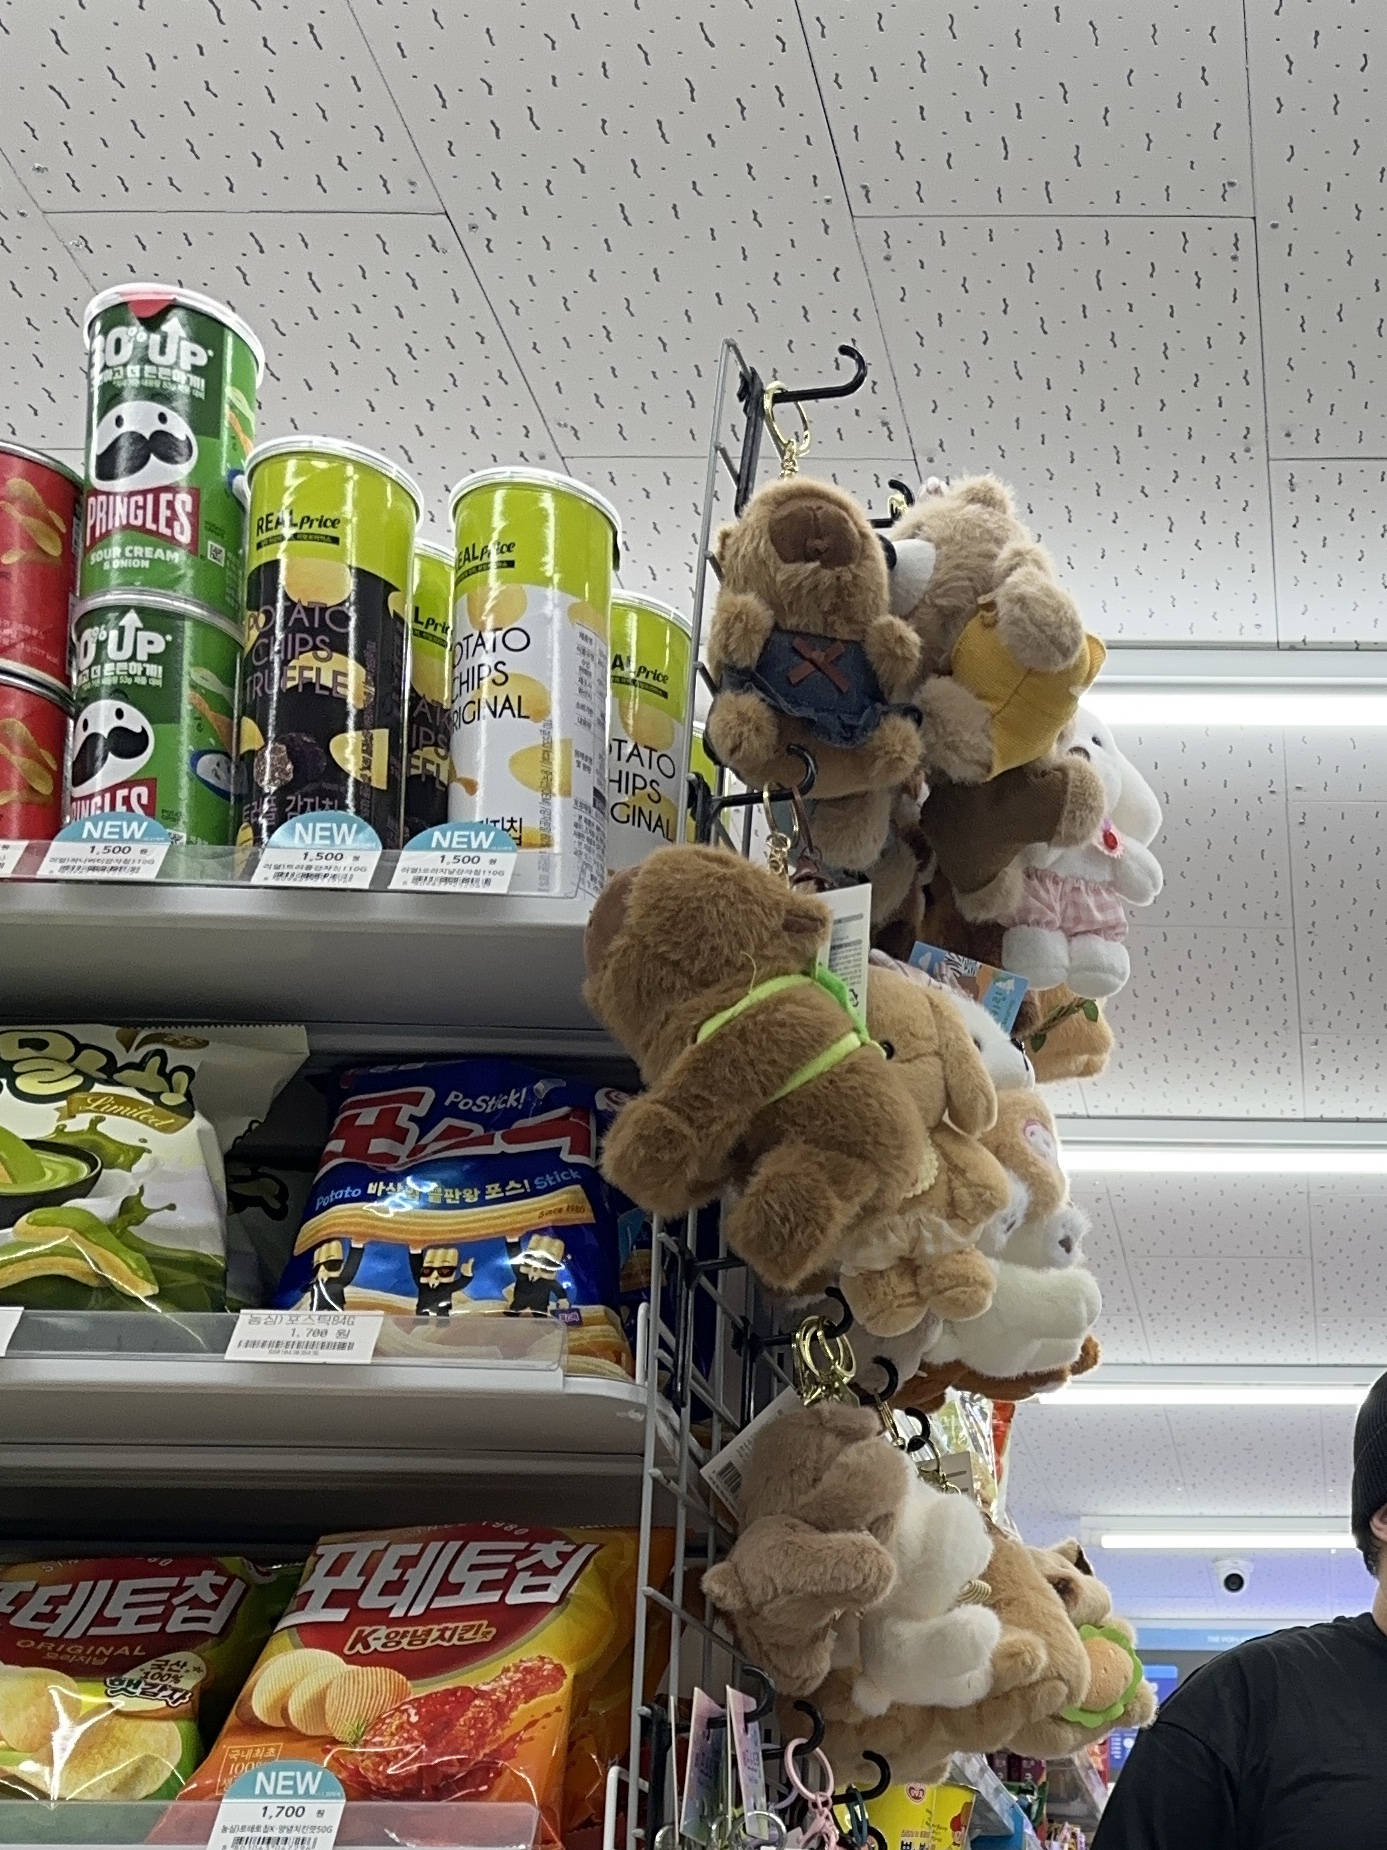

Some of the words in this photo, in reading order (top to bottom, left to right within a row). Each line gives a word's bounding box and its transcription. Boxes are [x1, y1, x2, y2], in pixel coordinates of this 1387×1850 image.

[86, 492, 192, 546] PRINGLES
[90, 547, 124, 569] SOUR
[125, 546, 180, 564] CREAM
[113, 558, 150, 570] ONION
[252, 634, 333, 667] CHIPS
[245, 666, 349, 701] TRUFFLE
[82, 821, 149, 840] NEW
[611, 802, 674, 843] GINAL
[293, 823, 358, 846] NEW
[431, 831, 496, 849] NEW
[89, 846, 132, 856] 1,500
[302, 852, 344, 863] 1,500
[438, 855, 480, 865] 1,500
[87, 1095, 175, 1128] Limited
[316, 1186, 362, 1211] Potato
[534, 1168, 582, 1190] Stick
[291, 1327, 328, 1338] 1,700
[273, 1539, 600, 1633] 포테토칩
[15, 1638, 147, 1657] ORIGINAL
[149, 1658, 188, 1673] 국산
[141, 1670, 184, 1684] 100%
[105, 1676, 195, 1708] 햇감자
[255, 1770, 323, 1796] NEW
[261, 1805, 306, 1820] 1,700
